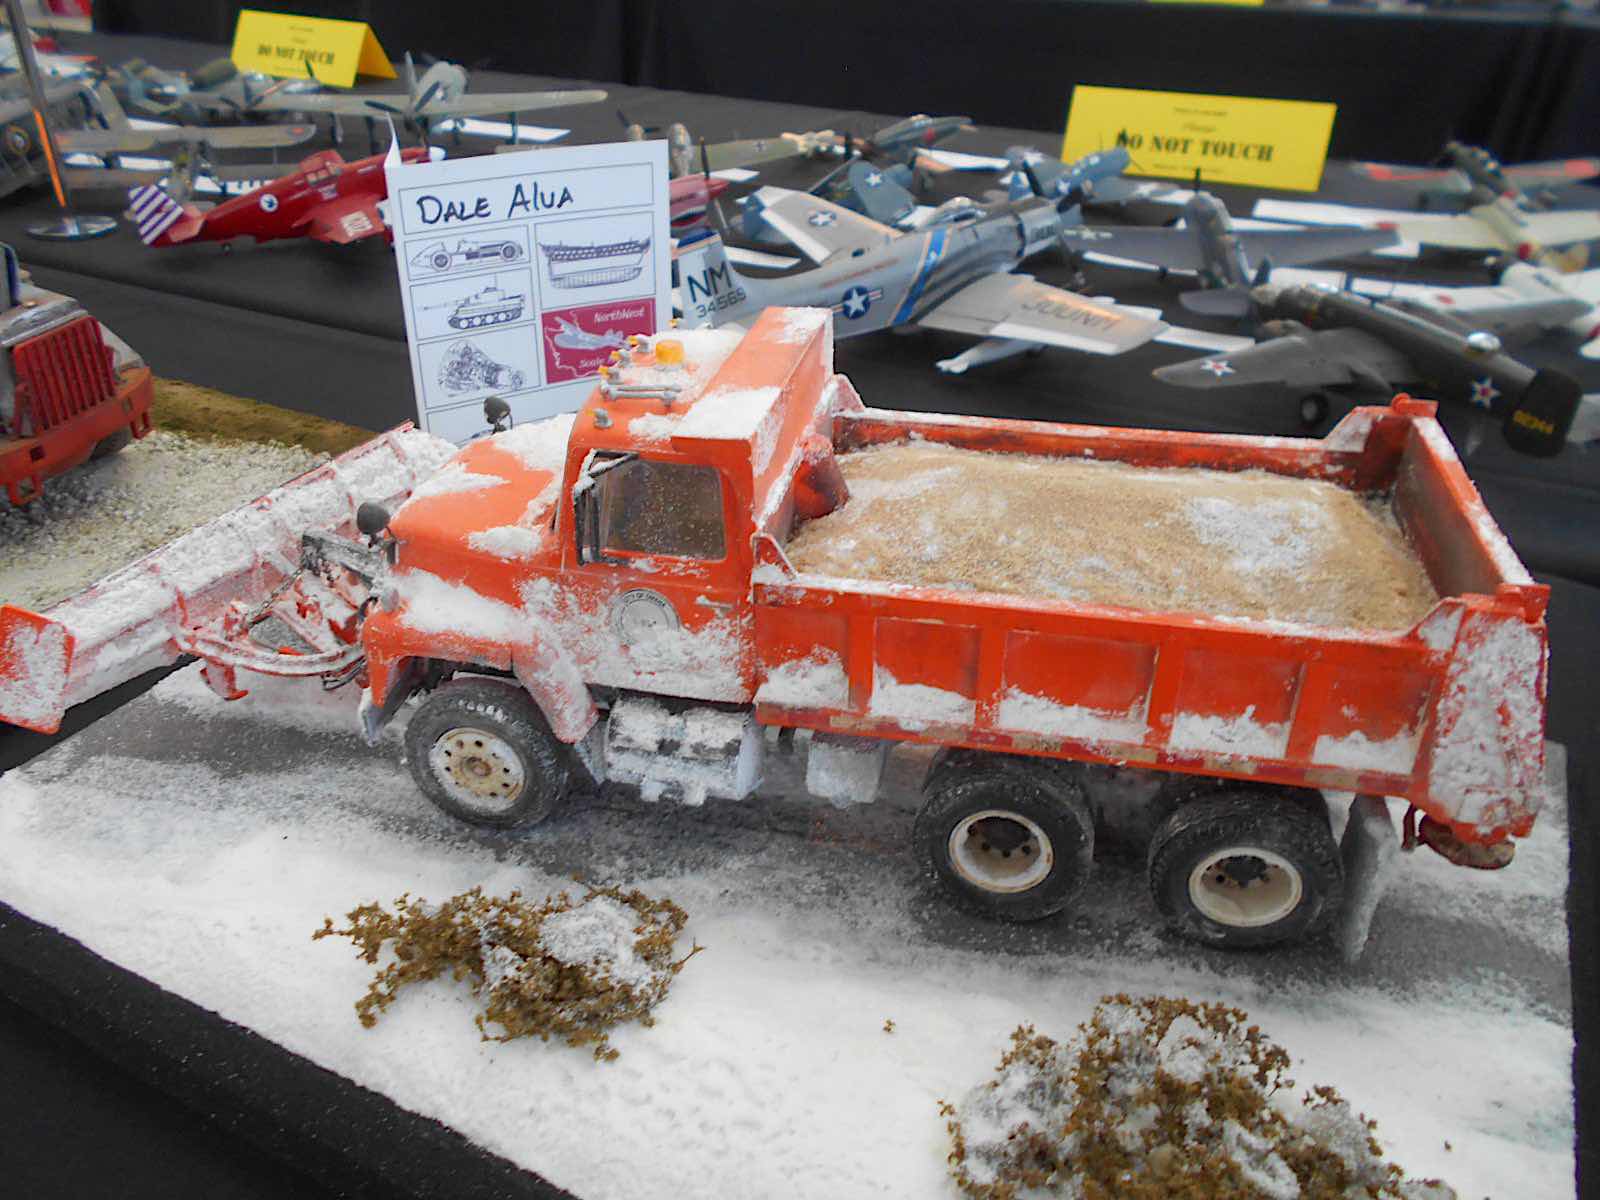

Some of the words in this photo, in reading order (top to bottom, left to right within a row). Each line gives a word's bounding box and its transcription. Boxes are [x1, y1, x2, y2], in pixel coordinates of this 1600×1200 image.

[1150, 136, 1194, 156] NOT
[1198, 139, 1275, 162] TOUCH
[416, 195, 491, 225] DALE
[687, 260, 732, 303] NM
